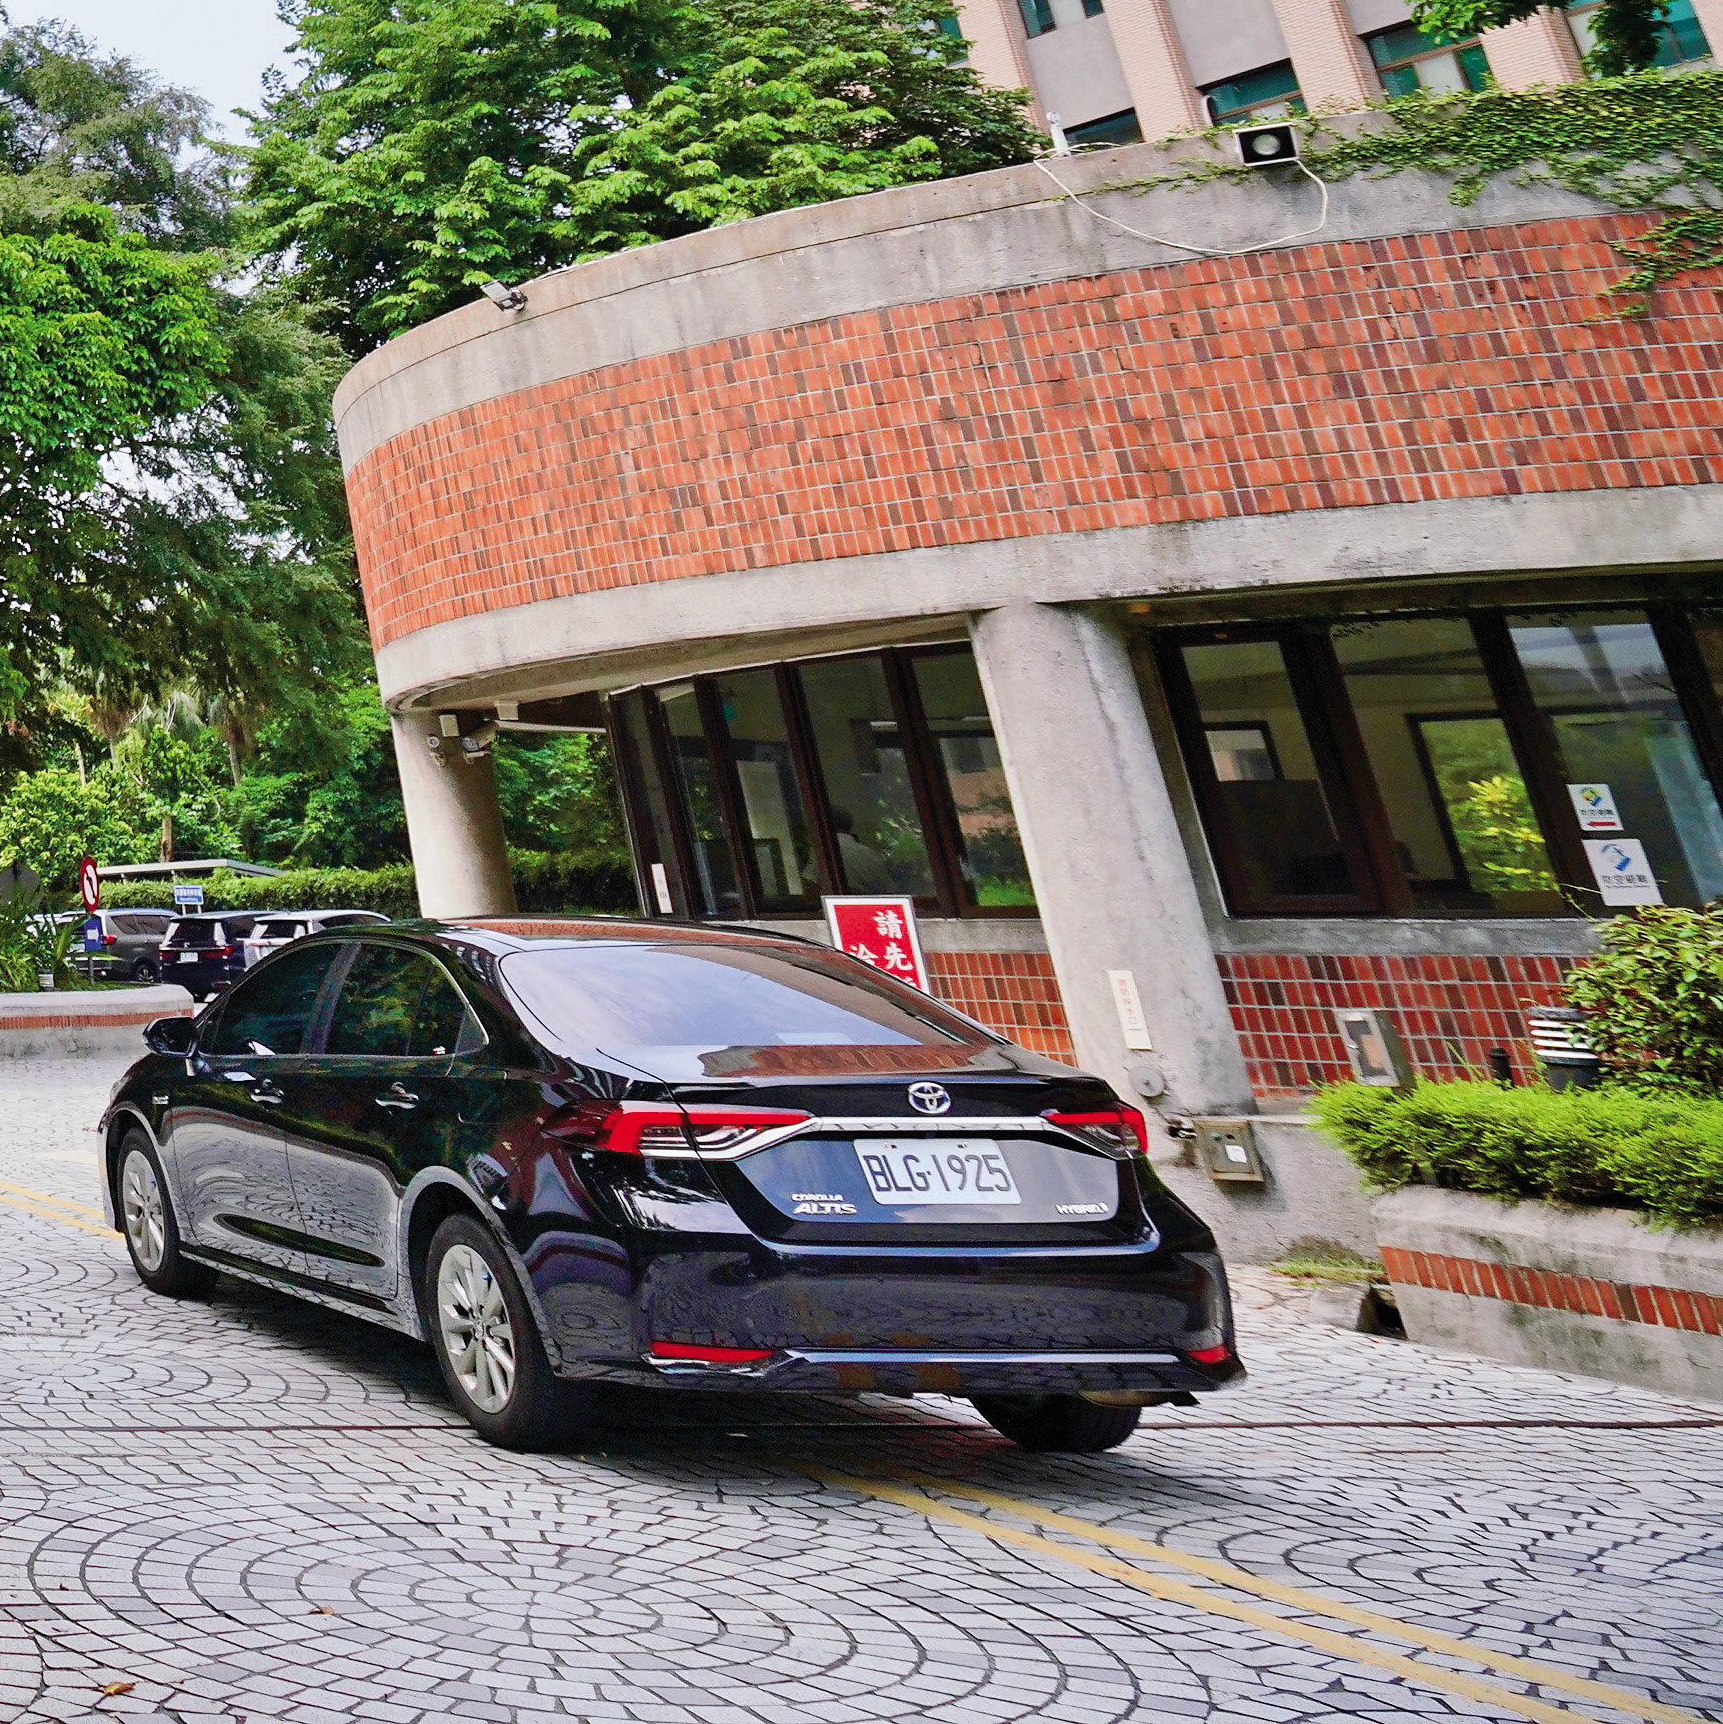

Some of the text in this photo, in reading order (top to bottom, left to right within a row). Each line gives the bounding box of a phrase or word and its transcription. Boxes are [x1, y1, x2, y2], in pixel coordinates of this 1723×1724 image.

[873, 909, 917, 987] 請先
[791, 1193, 844, 1202] COROLLA
[793, 1202, 858, 1215] ALTIS
[1054, 1203, 1105, 1215] HYBRID
